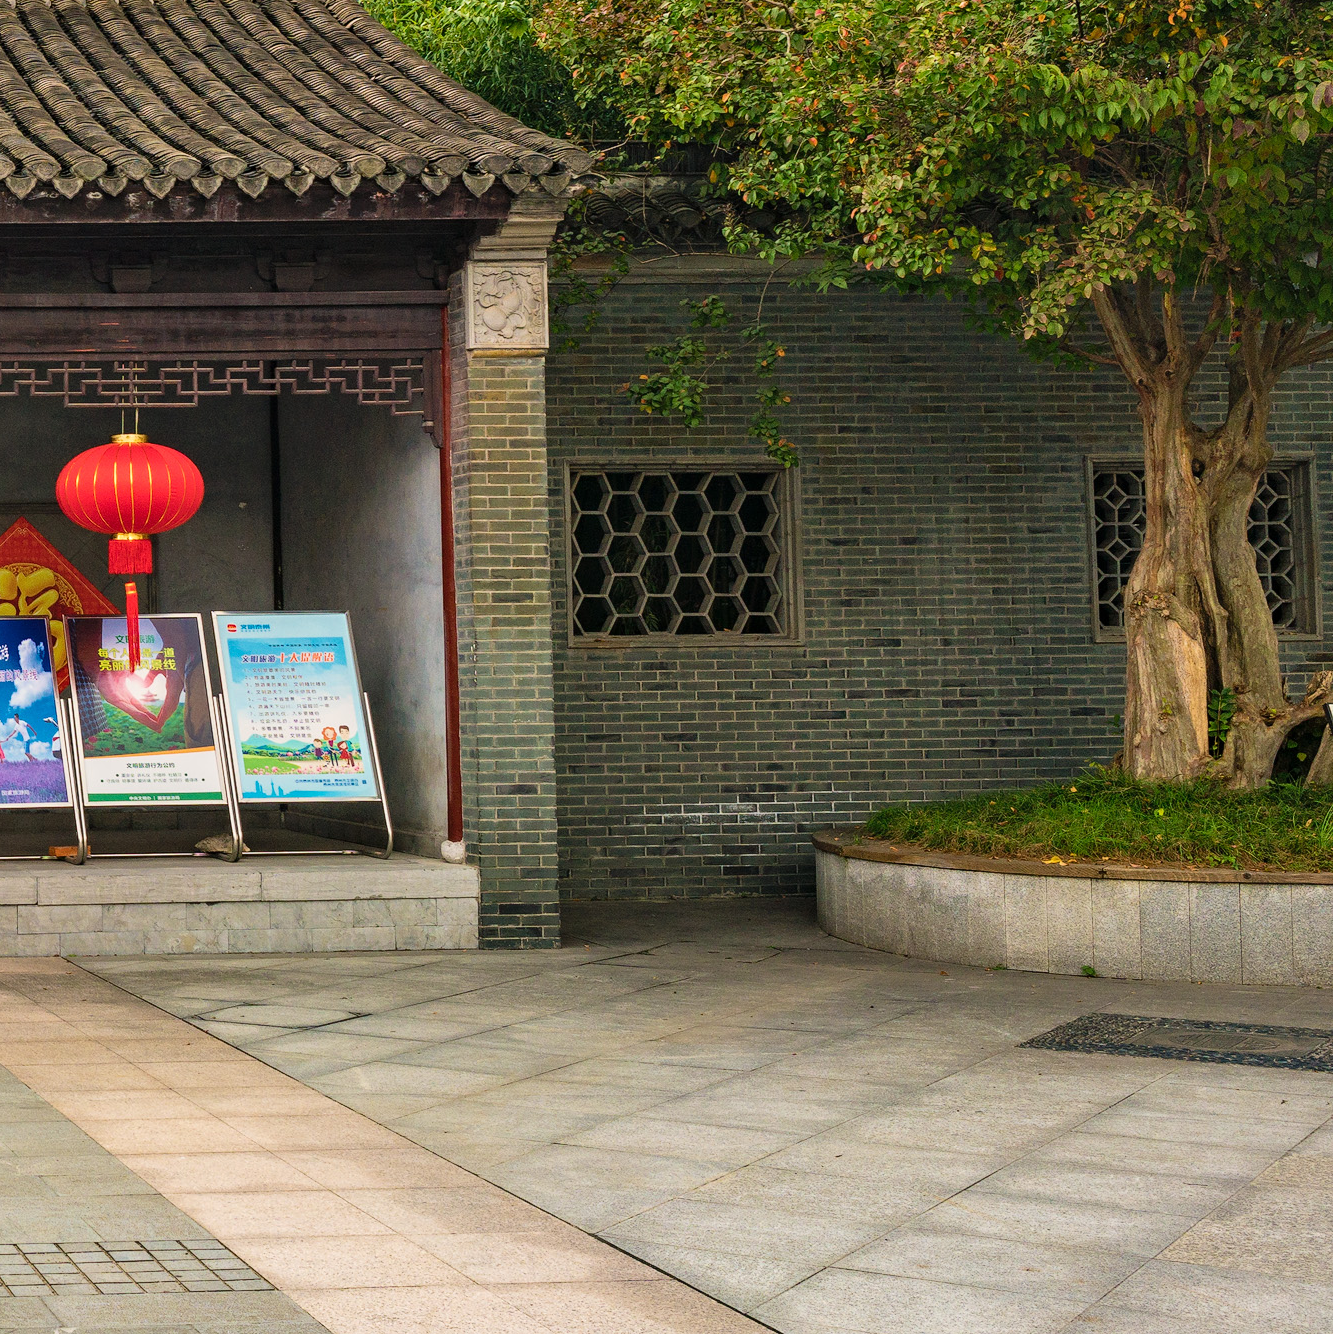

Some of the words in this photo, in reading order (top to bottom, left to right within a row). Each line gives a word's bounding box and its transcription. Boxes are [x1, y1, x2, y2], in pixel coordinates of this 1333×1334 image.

[115, 635, 155, 644] 文游
[98, 647, 175, 658] 每个人是一道
